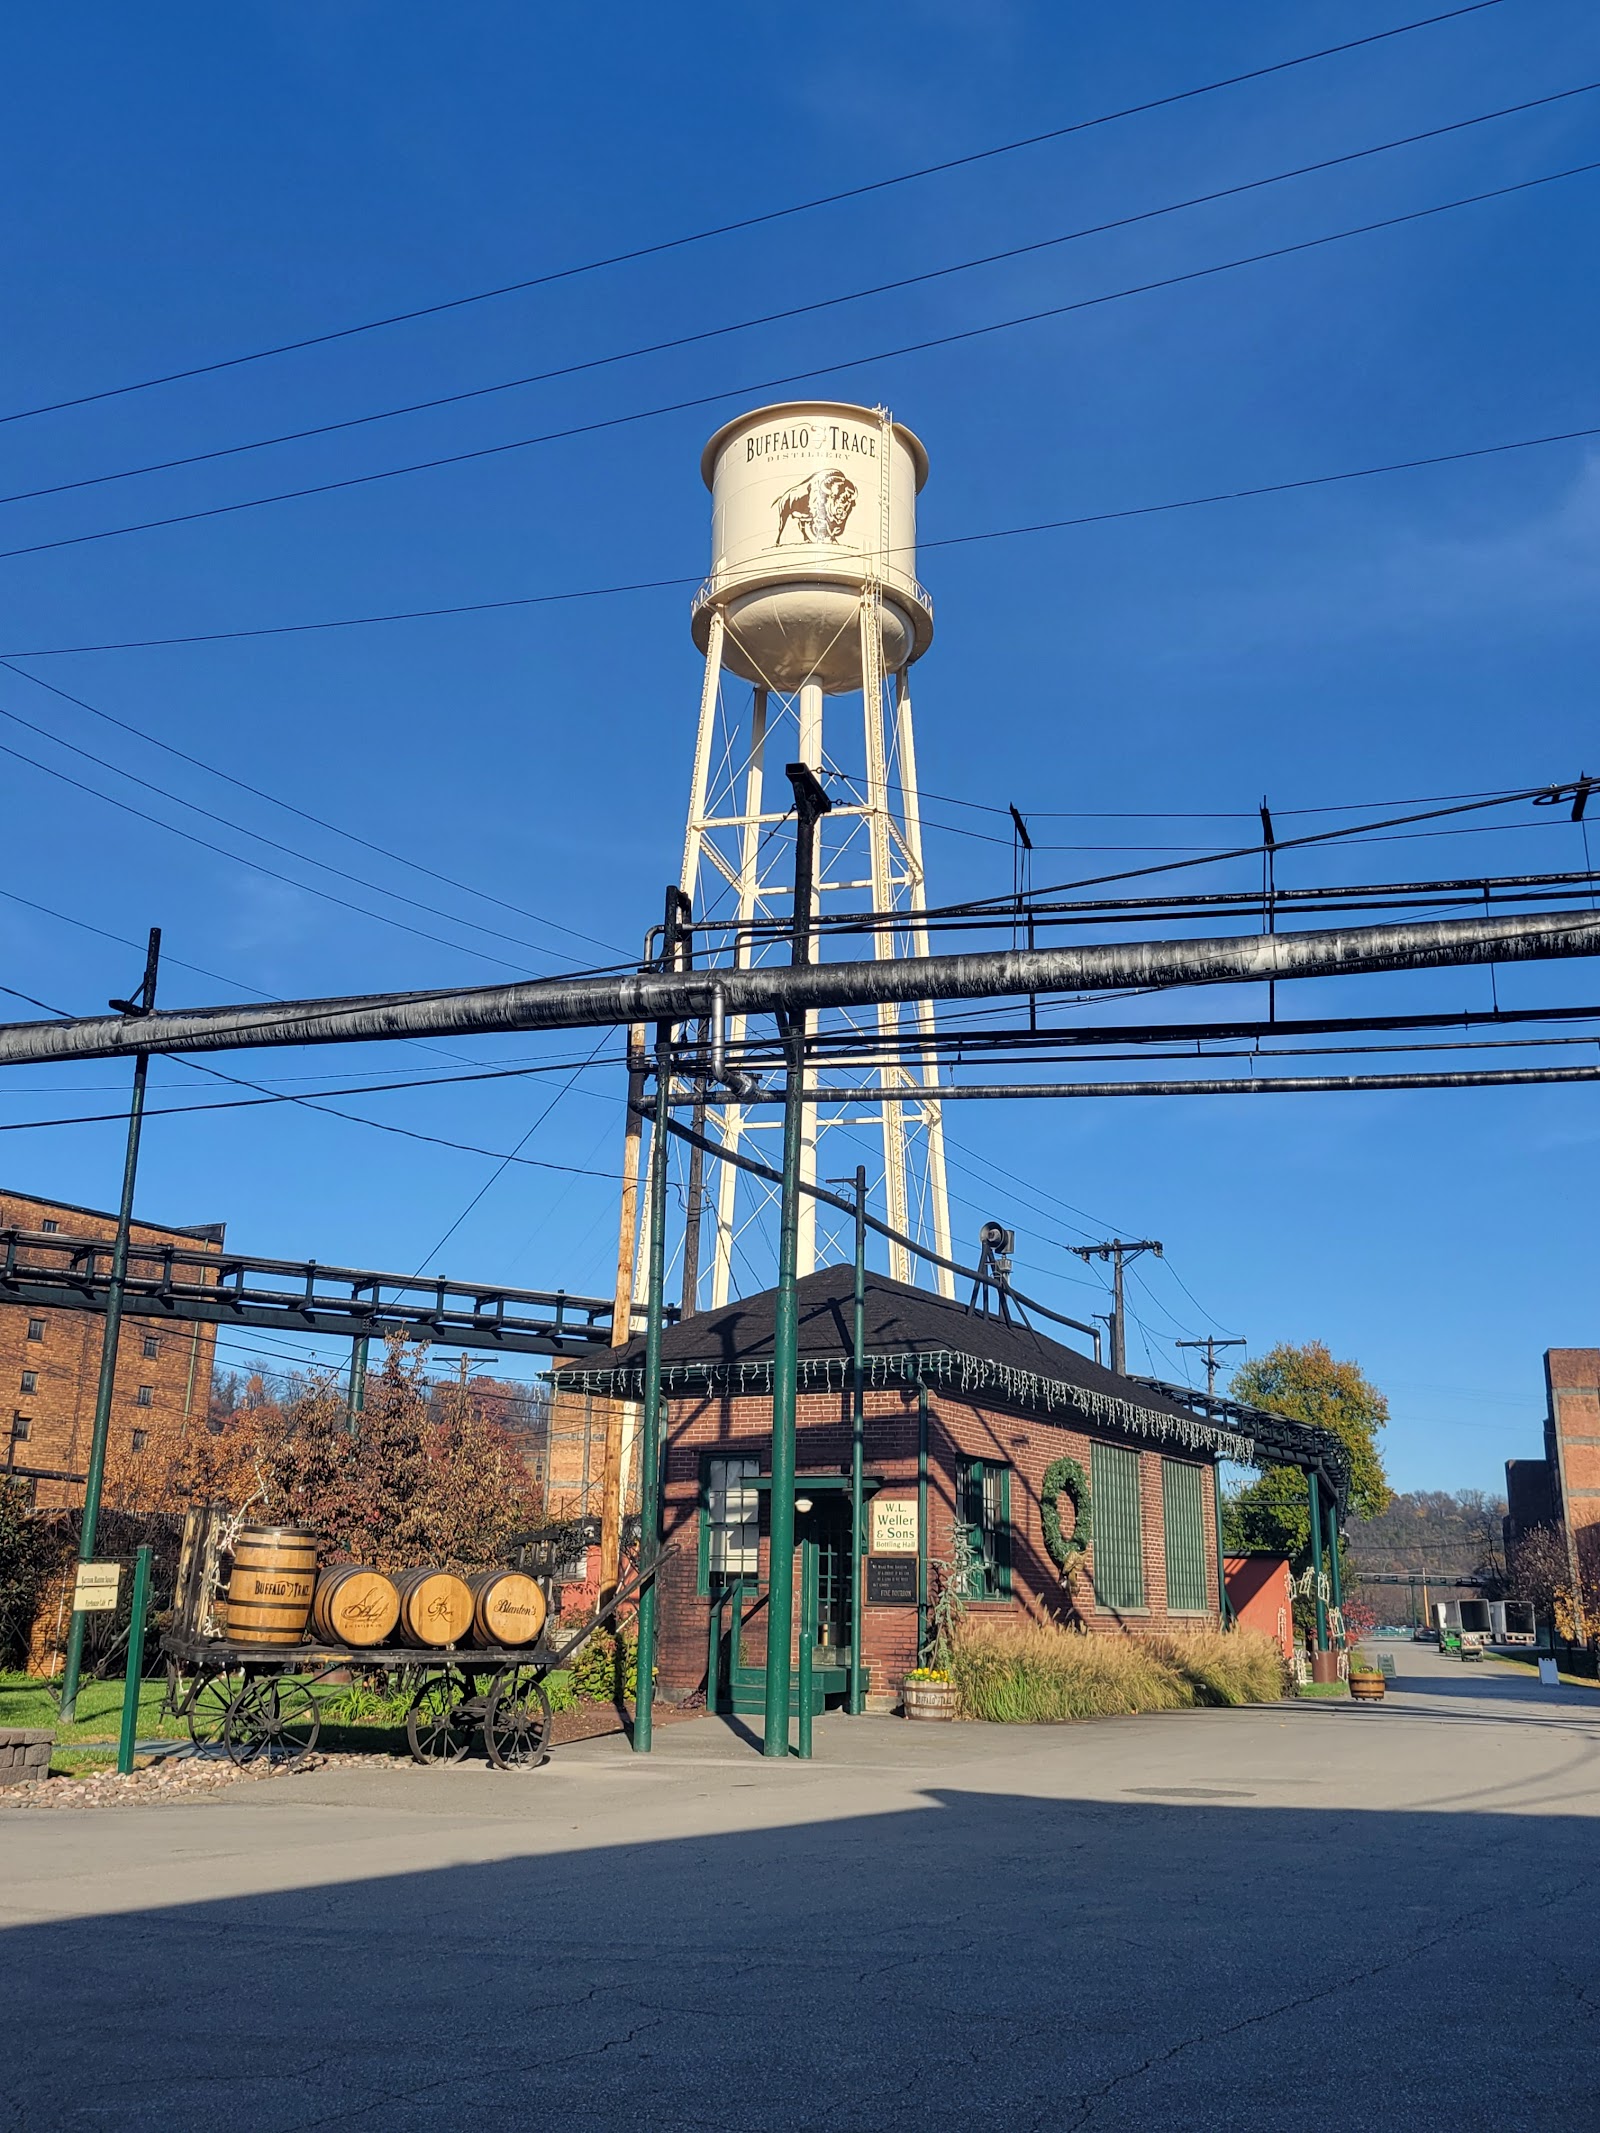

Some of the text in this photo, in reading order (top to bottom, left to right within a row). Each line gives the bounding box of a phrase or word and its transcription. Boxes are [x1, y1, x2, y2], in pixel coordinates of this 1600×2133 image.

[746, 426, 876, 463] BUFFALO TRACE
[767, 451, 851, 463] DISTILLERY
[885, 1503, 907, 1512] W.L.
[878, 1514, 915, 1526] Weller
[876, 1527, 915, 1539] & Sons
[876, 1541, 901, 1549] Bottling
[254, 1580, 286, 1596] BUFFALO
[494, 1600, 537, 1616] Blanton's
